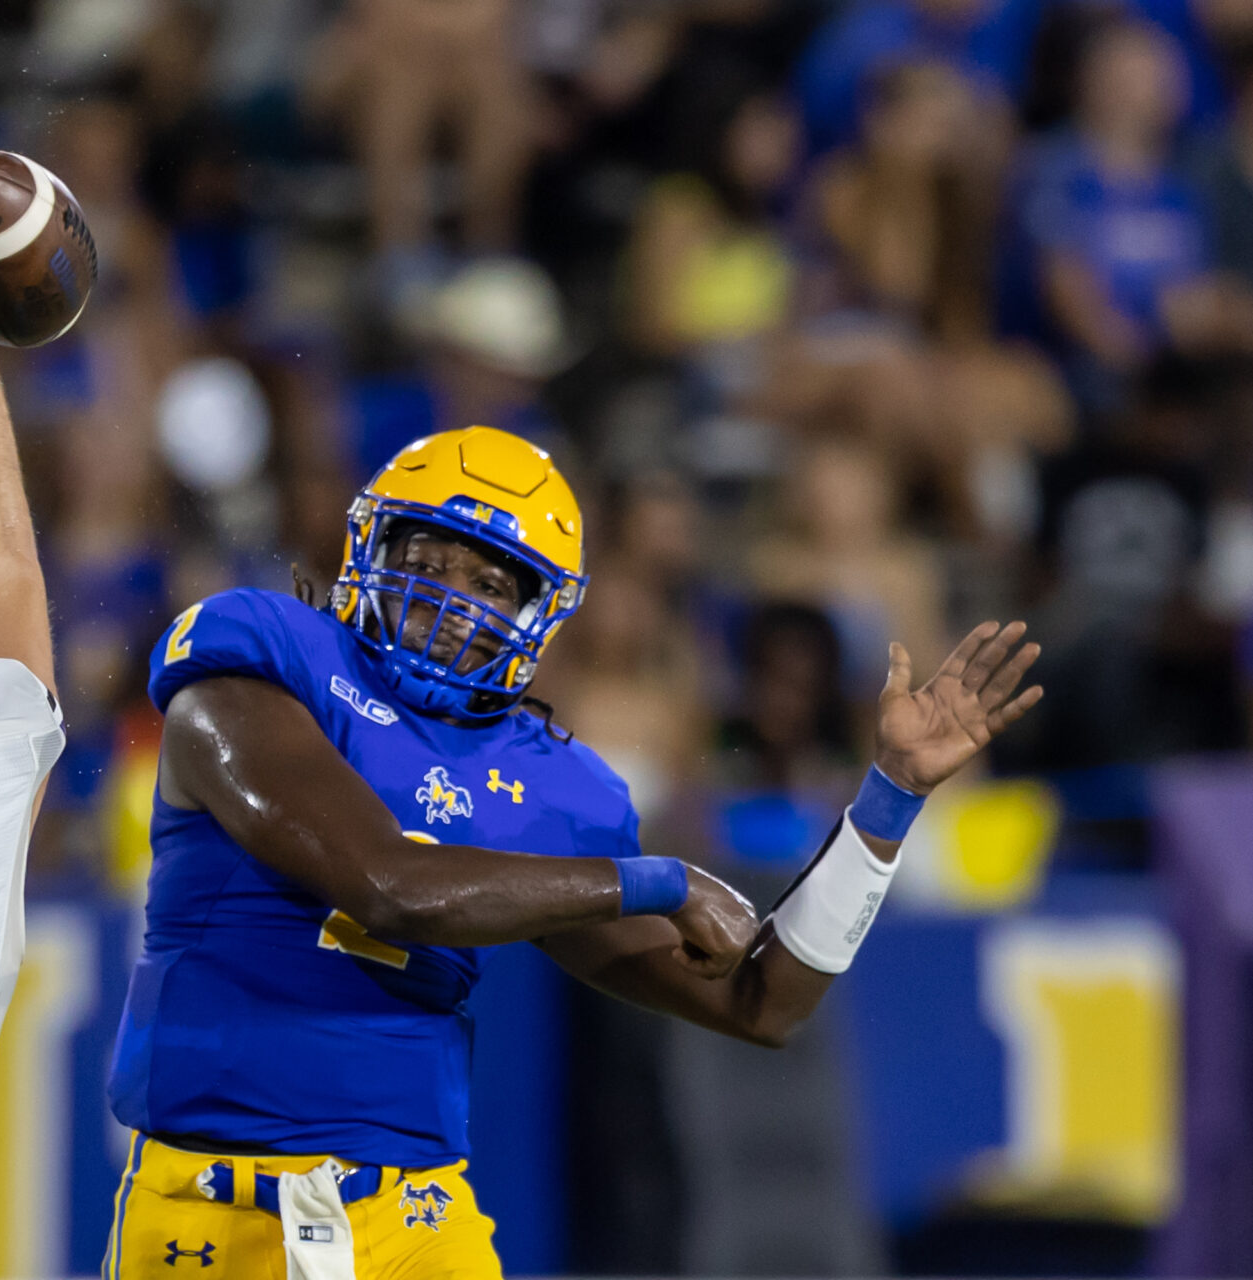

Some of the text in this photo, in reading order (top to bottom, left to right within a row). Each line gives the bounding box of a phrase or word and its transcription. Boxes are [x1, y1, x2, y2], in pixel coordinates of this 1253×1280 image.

[473, 503, 495, 525] M
[164, 602, 204, 667] 2
[330, 675, 399, 727] SLC
